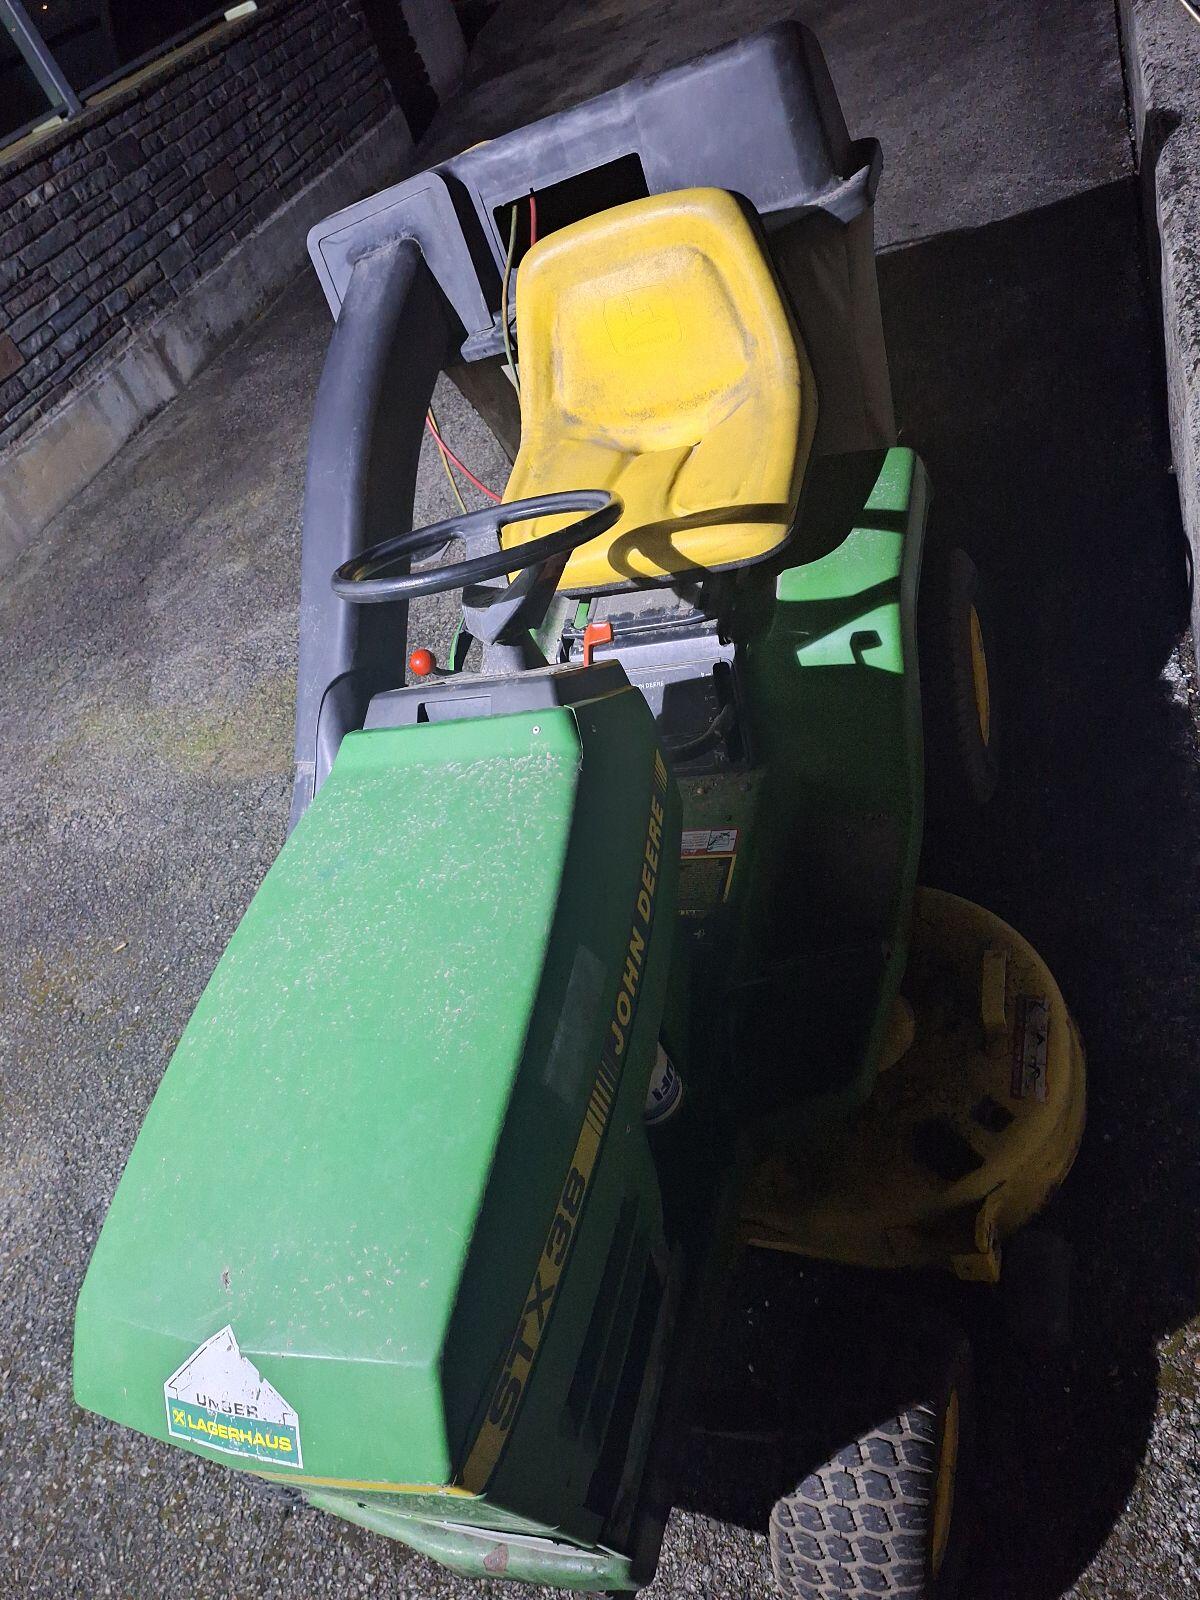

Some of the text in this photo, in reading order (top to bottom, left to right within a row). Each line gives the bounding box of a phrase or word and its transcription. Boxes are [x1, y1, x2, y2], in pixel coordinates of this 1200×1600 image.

[611, 795, 664, 1056] JOHN DEERE
[187, 1415, 292, 1452] LAGERHAUS
